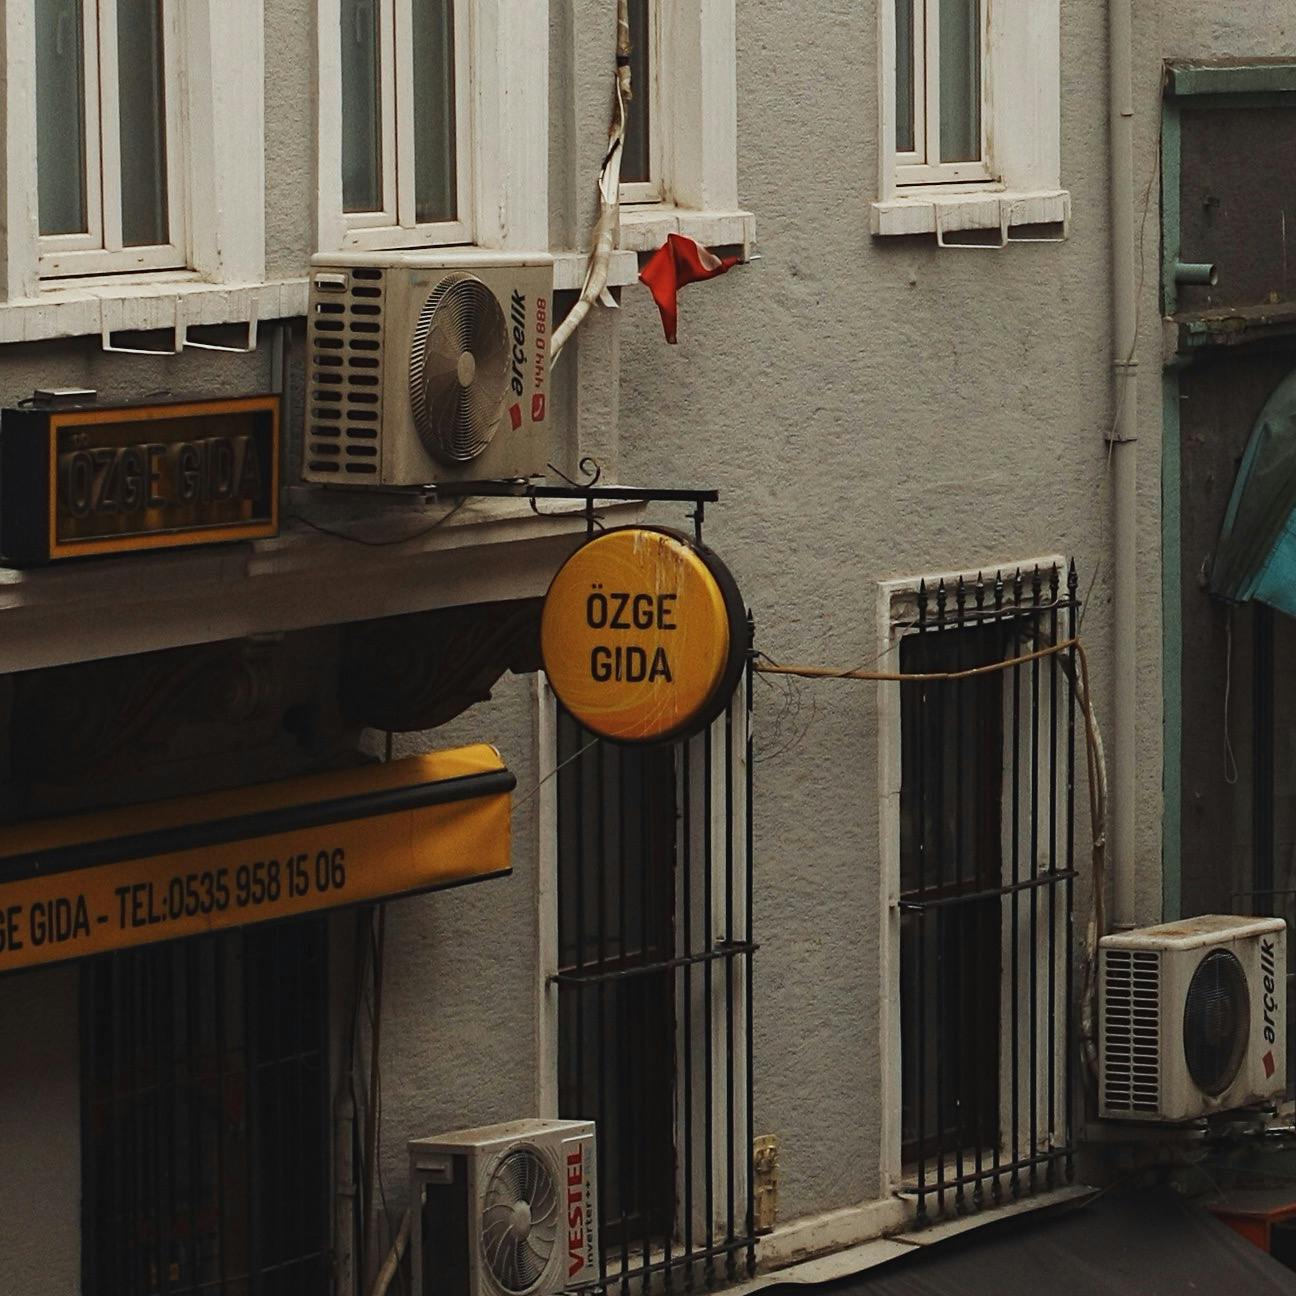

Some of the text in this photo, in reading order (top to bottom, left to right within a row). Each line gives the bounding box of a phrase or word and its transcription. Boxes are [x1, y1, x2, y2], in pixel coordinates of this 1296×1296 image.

[511, 289, 526, 396] arçelik
[586, 583, 677, 630] ÖZGE
[591, 646, 672, 683] GIDA
[29, 895, 91, 946] GIDA
[235, 861, 282, 907] 958
[286, 854, 309, 897] 15
[315, 848, 346, 893] 06
[1260, 937, 1276, 1045] arçelik
[567, 1143, 585, 1277] VESTEL
